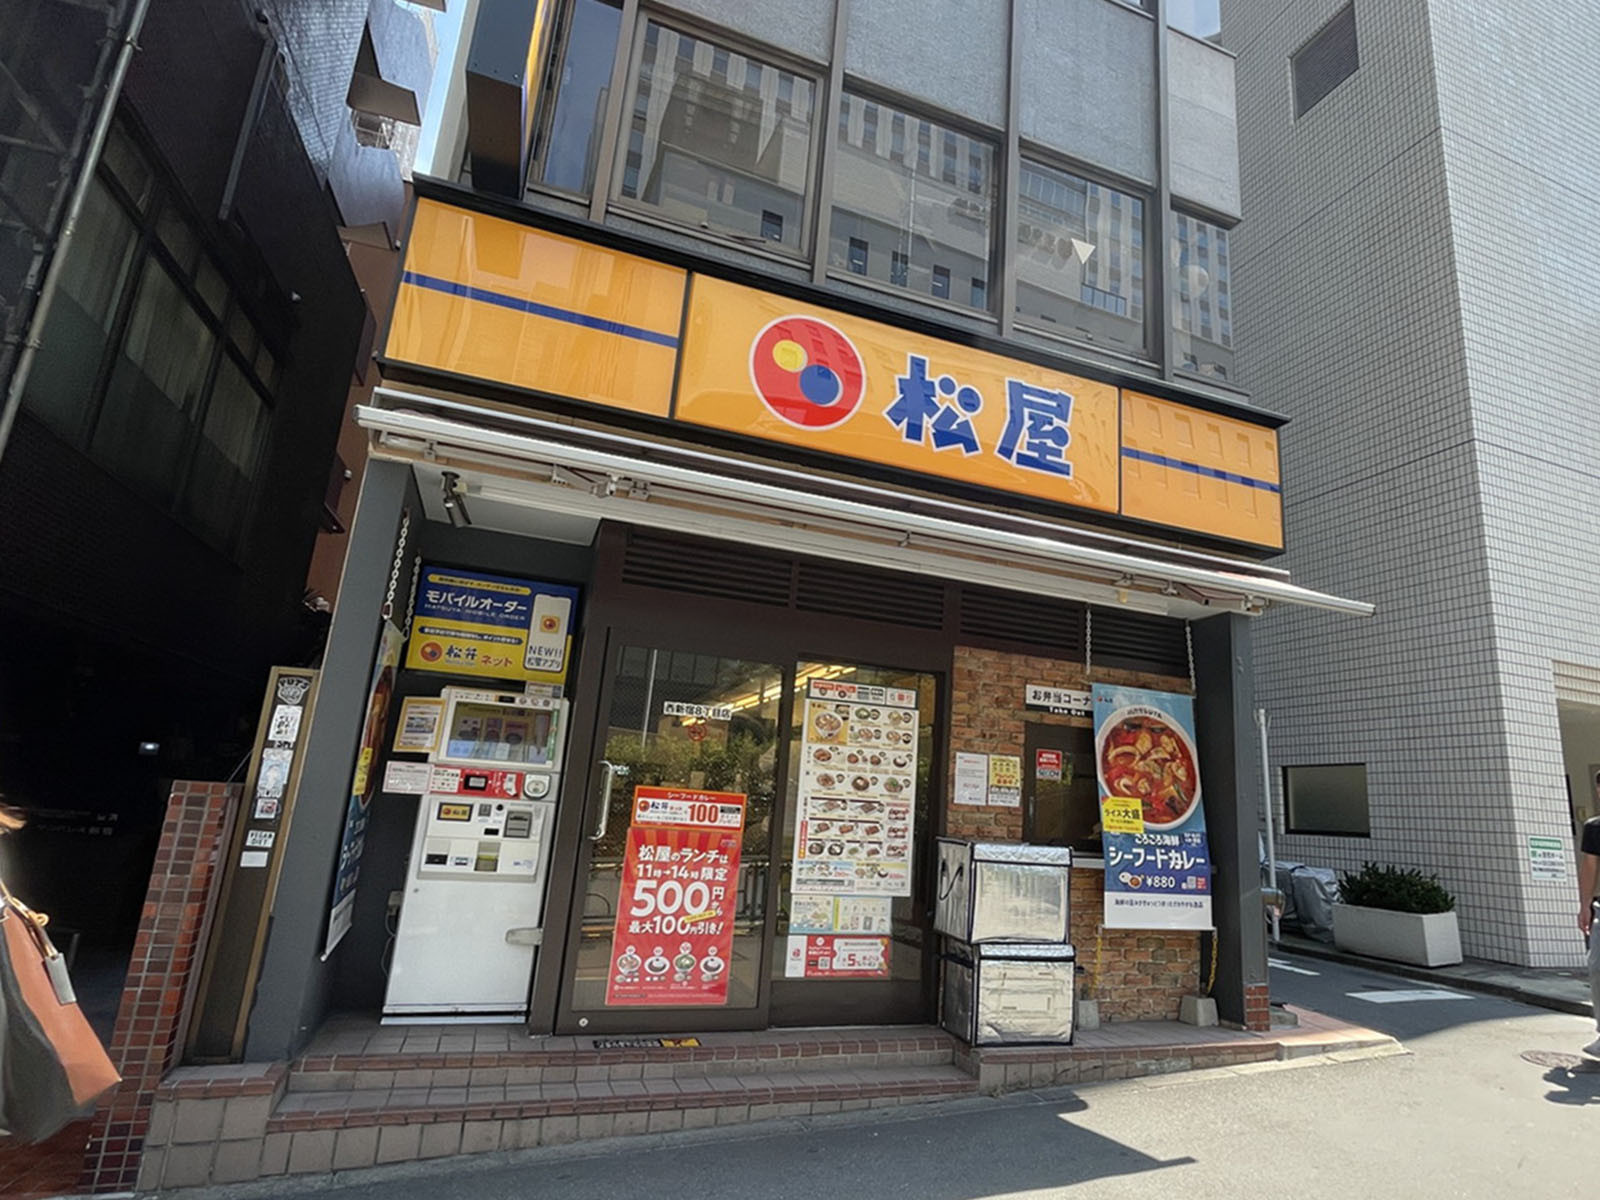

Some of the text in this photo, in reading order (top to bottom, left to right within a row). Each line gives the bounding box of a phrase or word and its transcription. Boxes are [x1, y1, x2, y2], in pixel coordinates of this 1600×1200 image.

[883, 353, 1074, 479] 松屋
[425, 589, 527, 613] モバイルオーダー
[528, 645, 562, 659] NEW!!
[1032, 689, 1092, 706] お弁当コーナ
[664, 702, 732, 720] 西新宿8丁目店
[687, 803, 719, 824] 100
[638, 844, 729, 864] 松屋のランチは
[1108, 846, 1206, 870] シーフードカレー
[1146, 875, 1176, 889] ¥880
